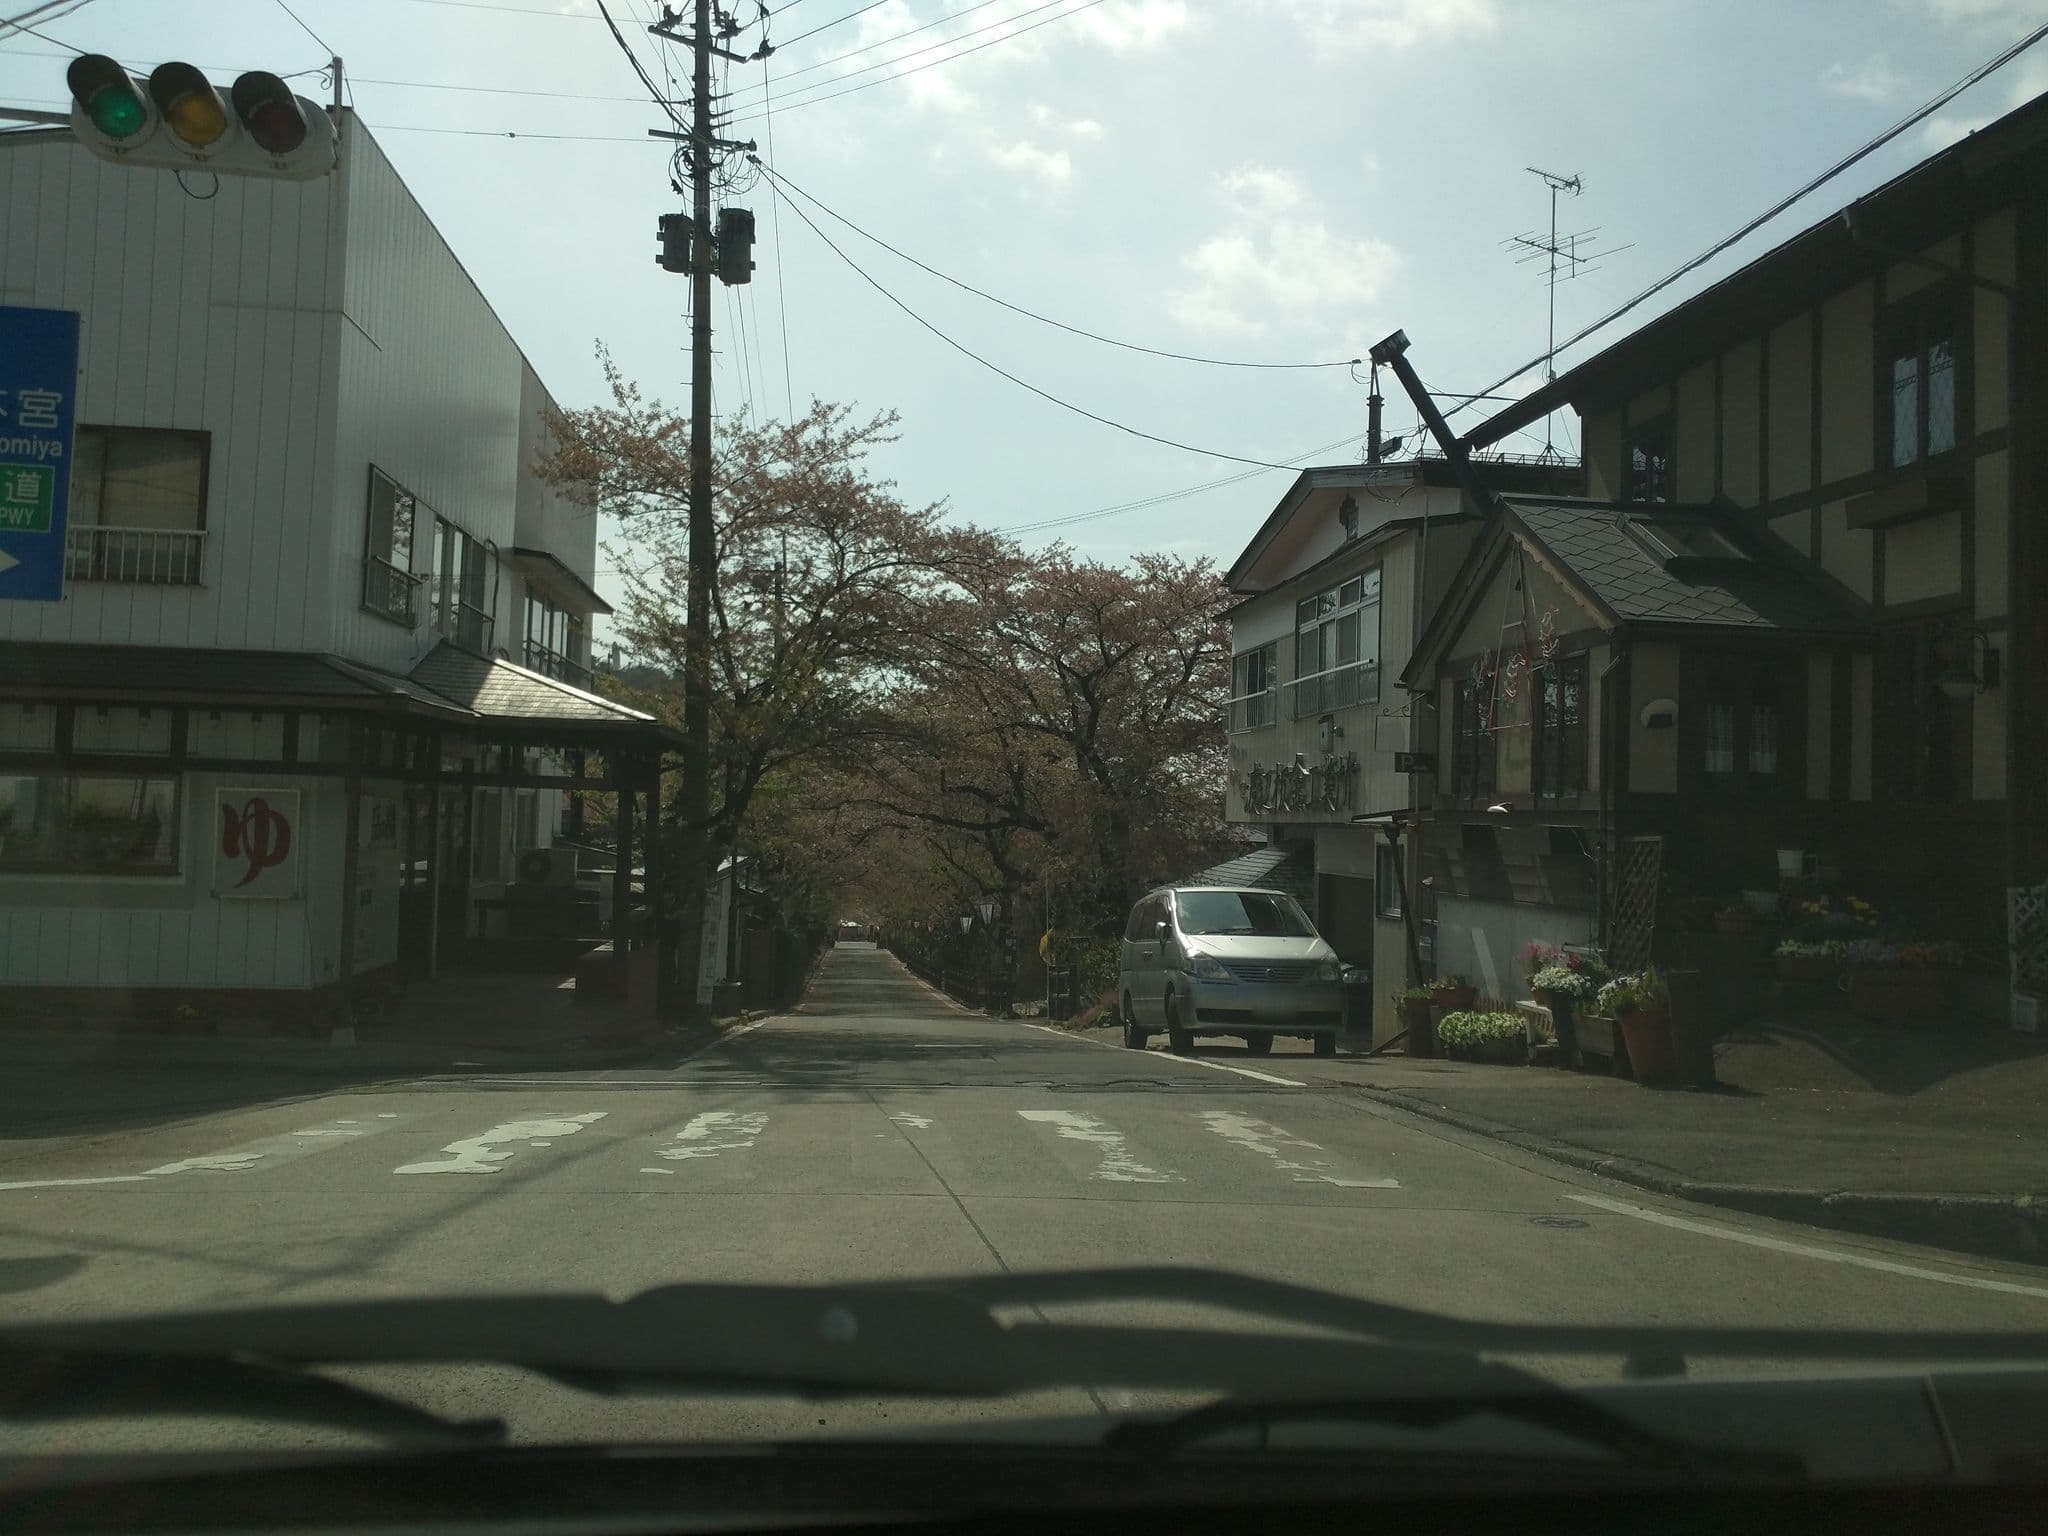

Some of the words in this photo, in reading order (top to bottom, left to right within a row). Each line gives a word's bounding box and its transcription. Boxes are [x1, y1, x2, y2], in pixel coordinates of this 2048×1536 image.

[0, 388, 63, 428] 宮
[0, 434, 63, 461] omiya
[5, 471, 42, 504] 道
[222, 796, 292, 888] ゆ
